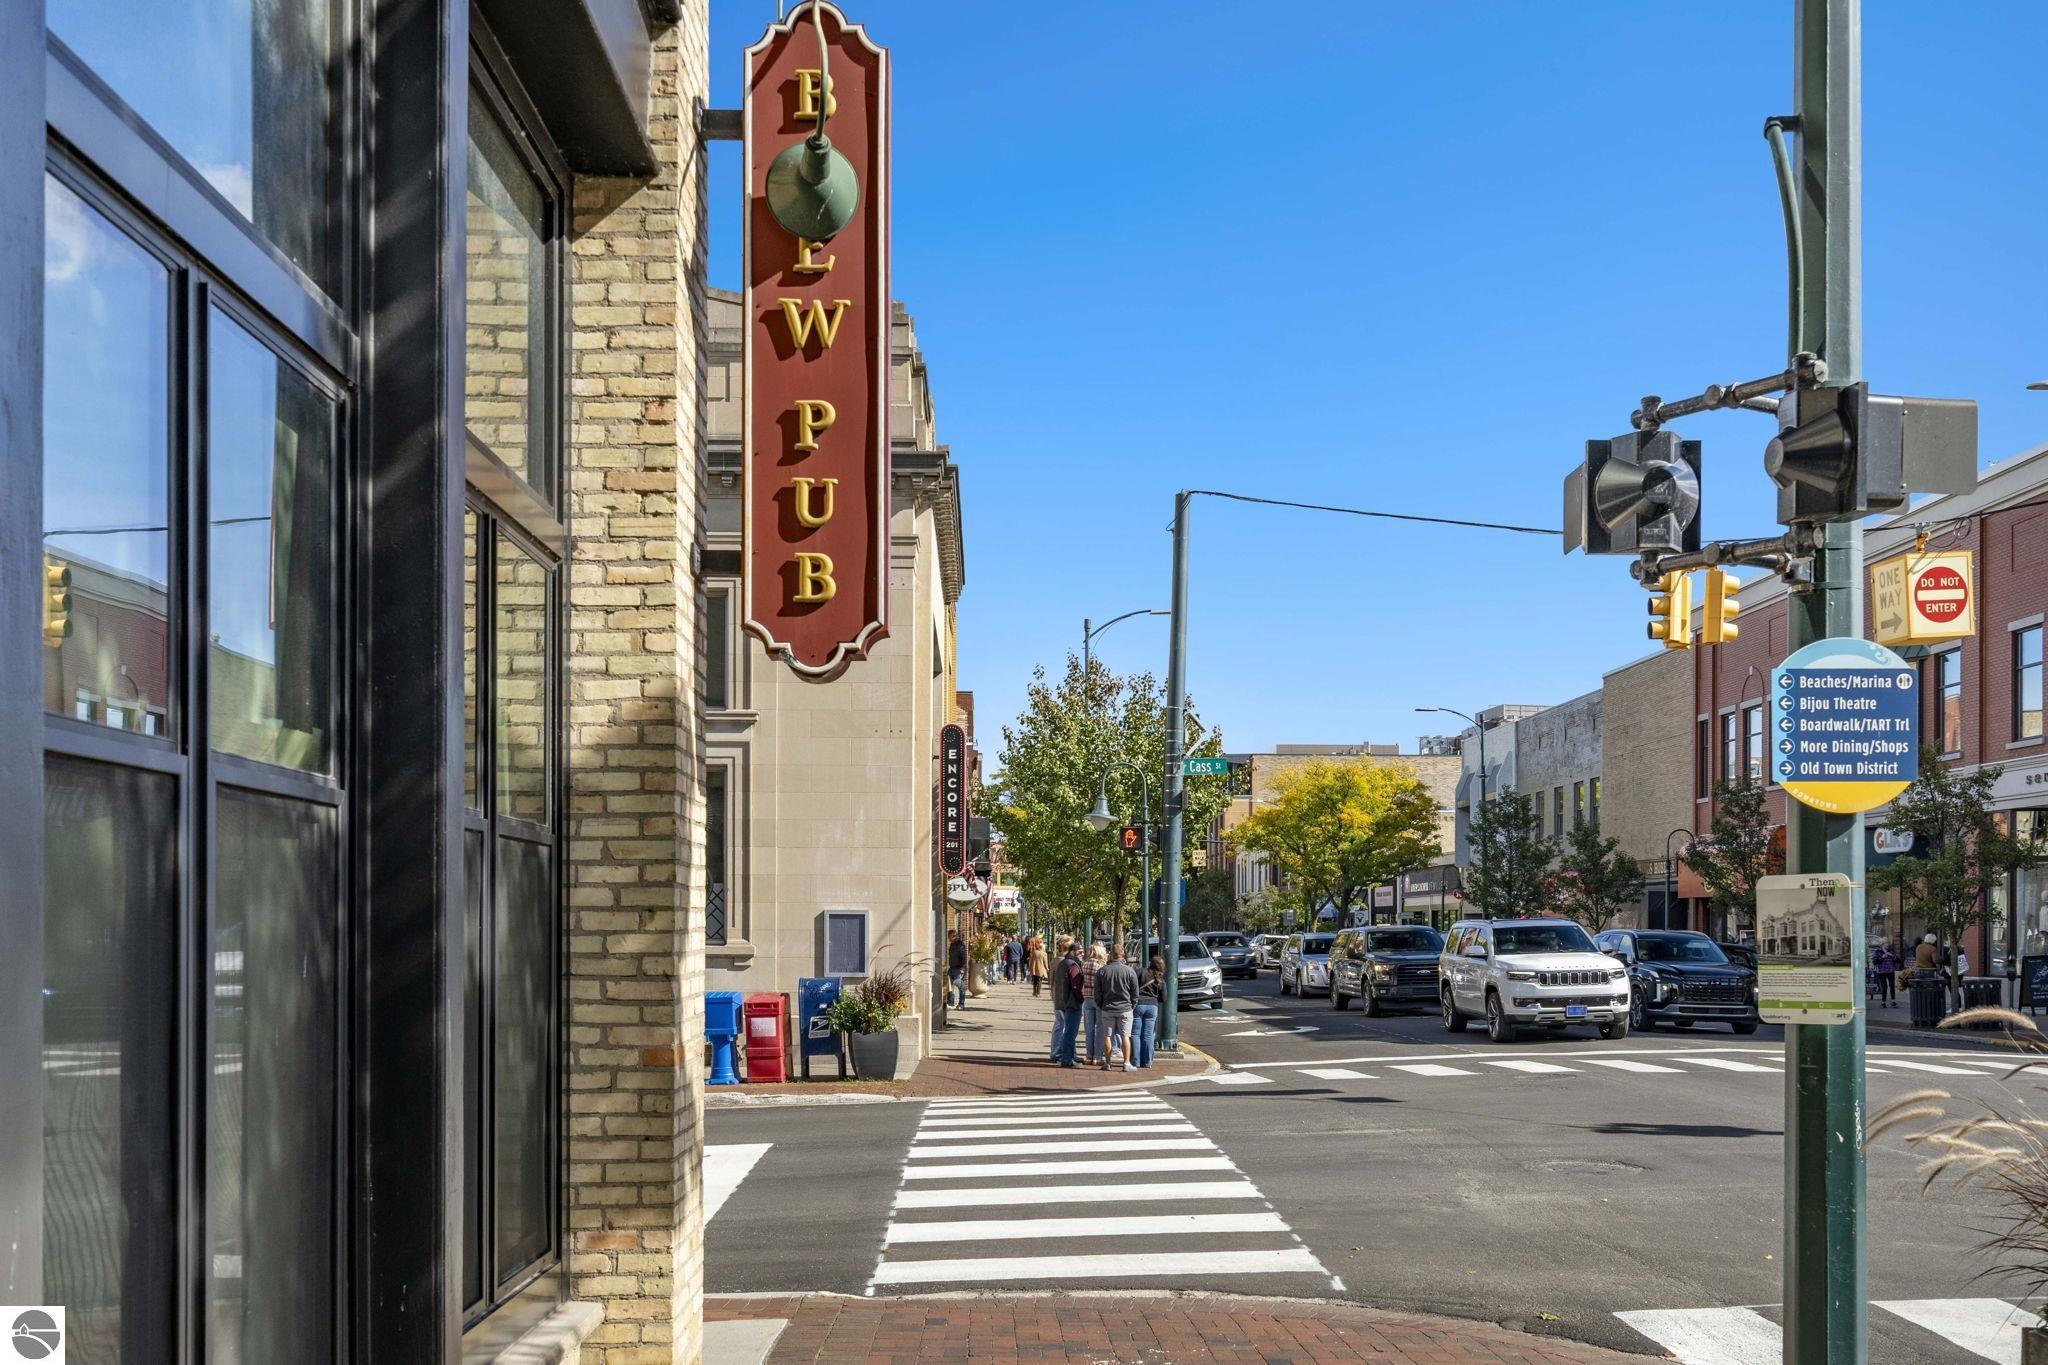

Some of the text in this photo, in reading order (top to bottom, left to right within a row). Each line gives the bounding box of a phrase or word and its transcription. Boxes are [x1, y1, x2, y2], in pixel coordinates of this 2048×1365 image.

[777, 69, 851, 602] BEW PUB
[1879, 567, 1901, 588] ONE
[1921, 576, 1960, 587] DO NOT
[1879, 588, 1902, 610] WAY
[1926, 602, 1957, 613] ENTER
[1800, 675, 1892, 690] Beaches/Marina
[1800, 697, 1877, 713] Bijou Theatre
[1800, 718, 1910, 733] Boardwalk/TART Trl
[1800, 739, 1909, 755] More Dining/Shops
[1189, 760, 1212, 773] Cass
[1800, 761, 1898, 775] Old Town District
[948, 749, 958, 832] ENCORE
[1792, 788, 1838, 810] DOWNTOWN
[1808, 877, 1835, 887] Then
[1817, 886, 1836, 897] NOW
